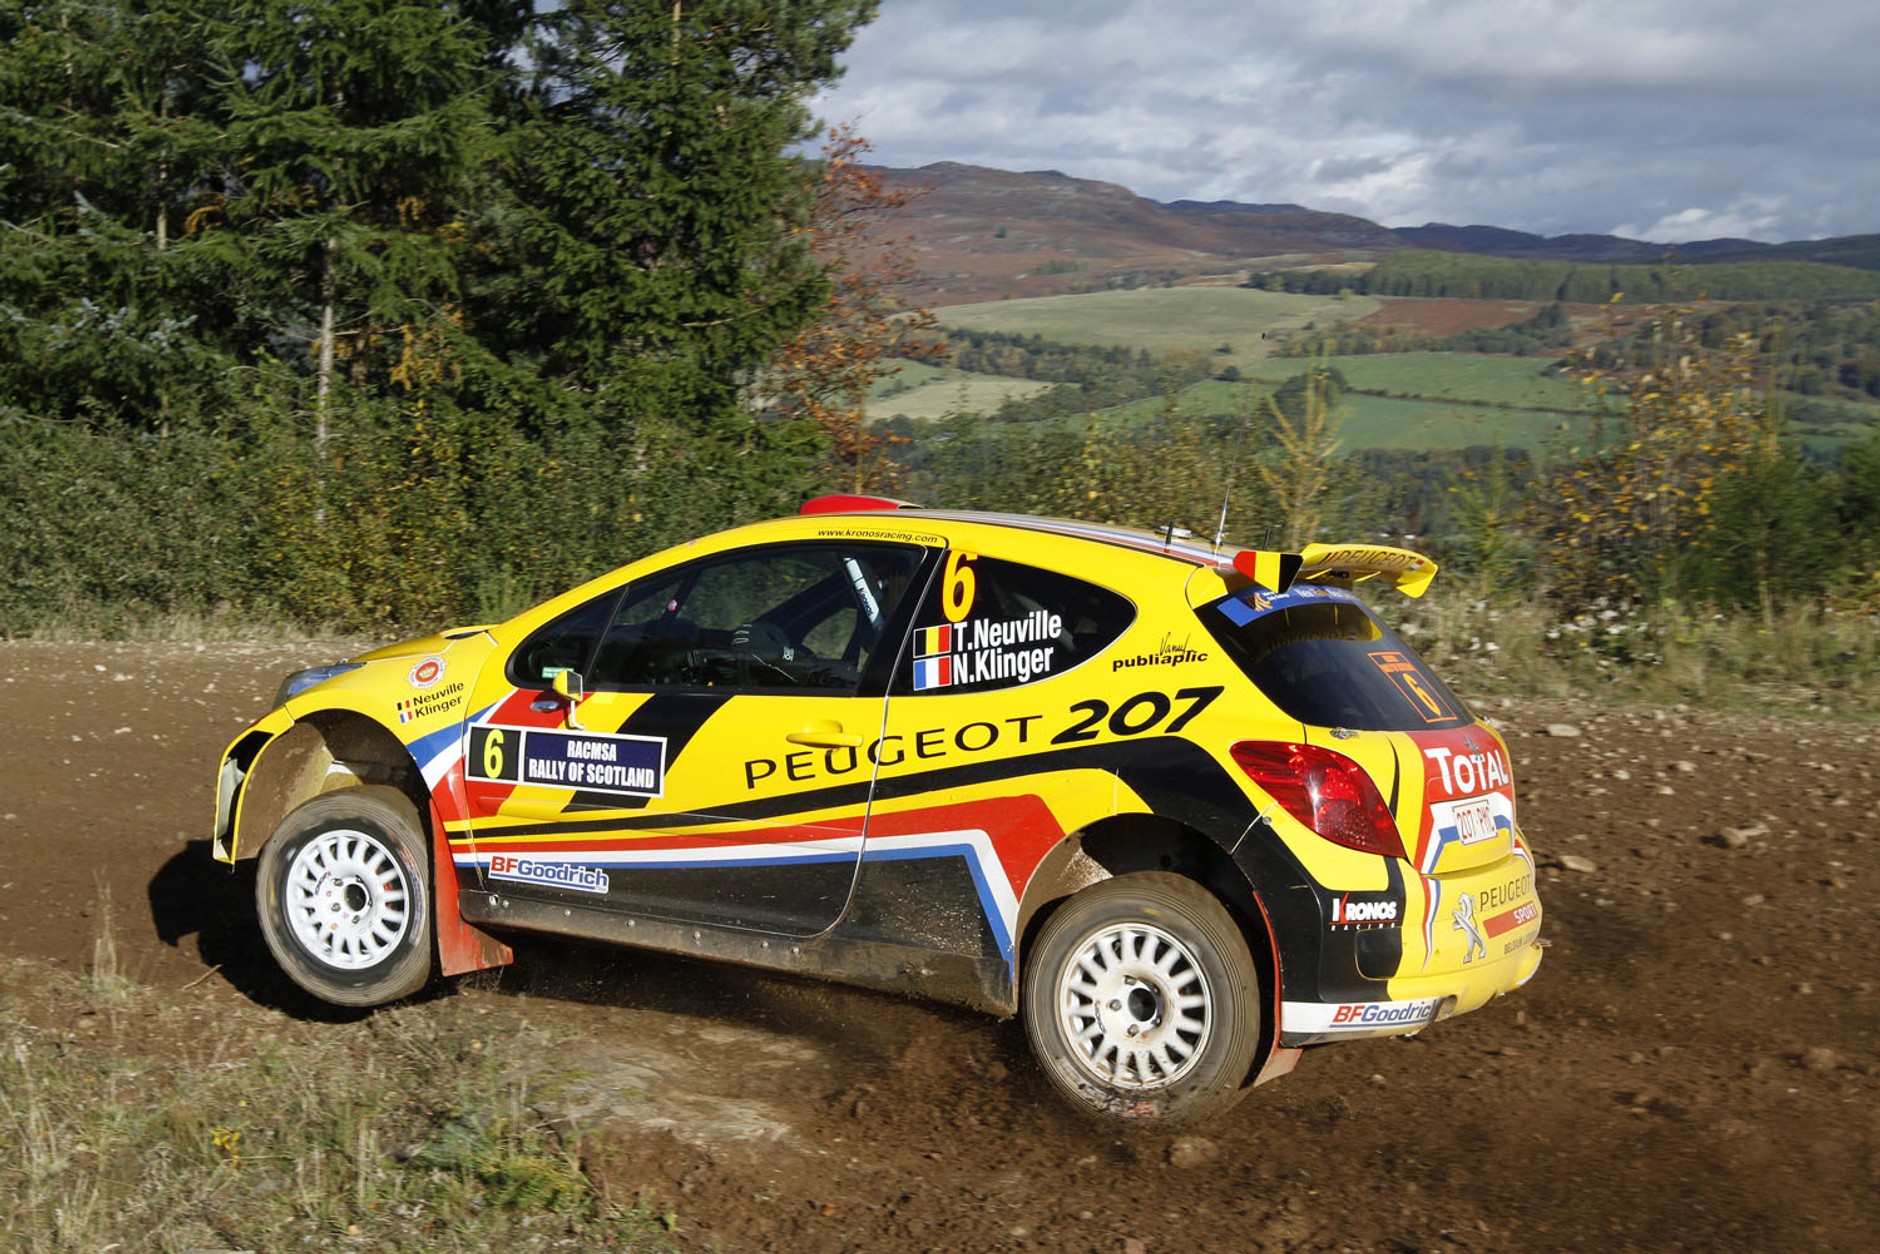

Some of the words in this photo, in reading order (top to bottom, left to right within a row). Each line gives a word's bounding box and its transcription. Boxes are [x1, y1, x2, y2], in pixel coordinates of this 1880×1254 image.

[818, 528, 938, 544] www.kronosracing.com
[1336, 550, 1417, 569] PEUGEOT
[942, 550, 978, 622] 6
[954, 610, 1062, 652] T.Neuville
[953, 646, 1054, 685] N.Klinger
[413, 682, 464, 706] Neuville
[415, 695, 462, 718] Klinger
[1402, 673, 1441, 716] 6
[567, 740, 617, 762] RACMSA
[744, 715, 1043, 790] PEUGEOT
[1050, 686, 1225, 745] 207
[483, 729, 504, 779] 6
[528, 758, 566, 782] RALLY
[568, 763, 584, 783] OF
[586, 766, 655, 789] SCOTLAND
[491, 856, 608, 887] BFGoodrich
[1332, 892, 1397, 923] KRONOS
[1480, 874, 1531, 912] PEUGEOT
[1513, 903, 1537, 924] SPORT
